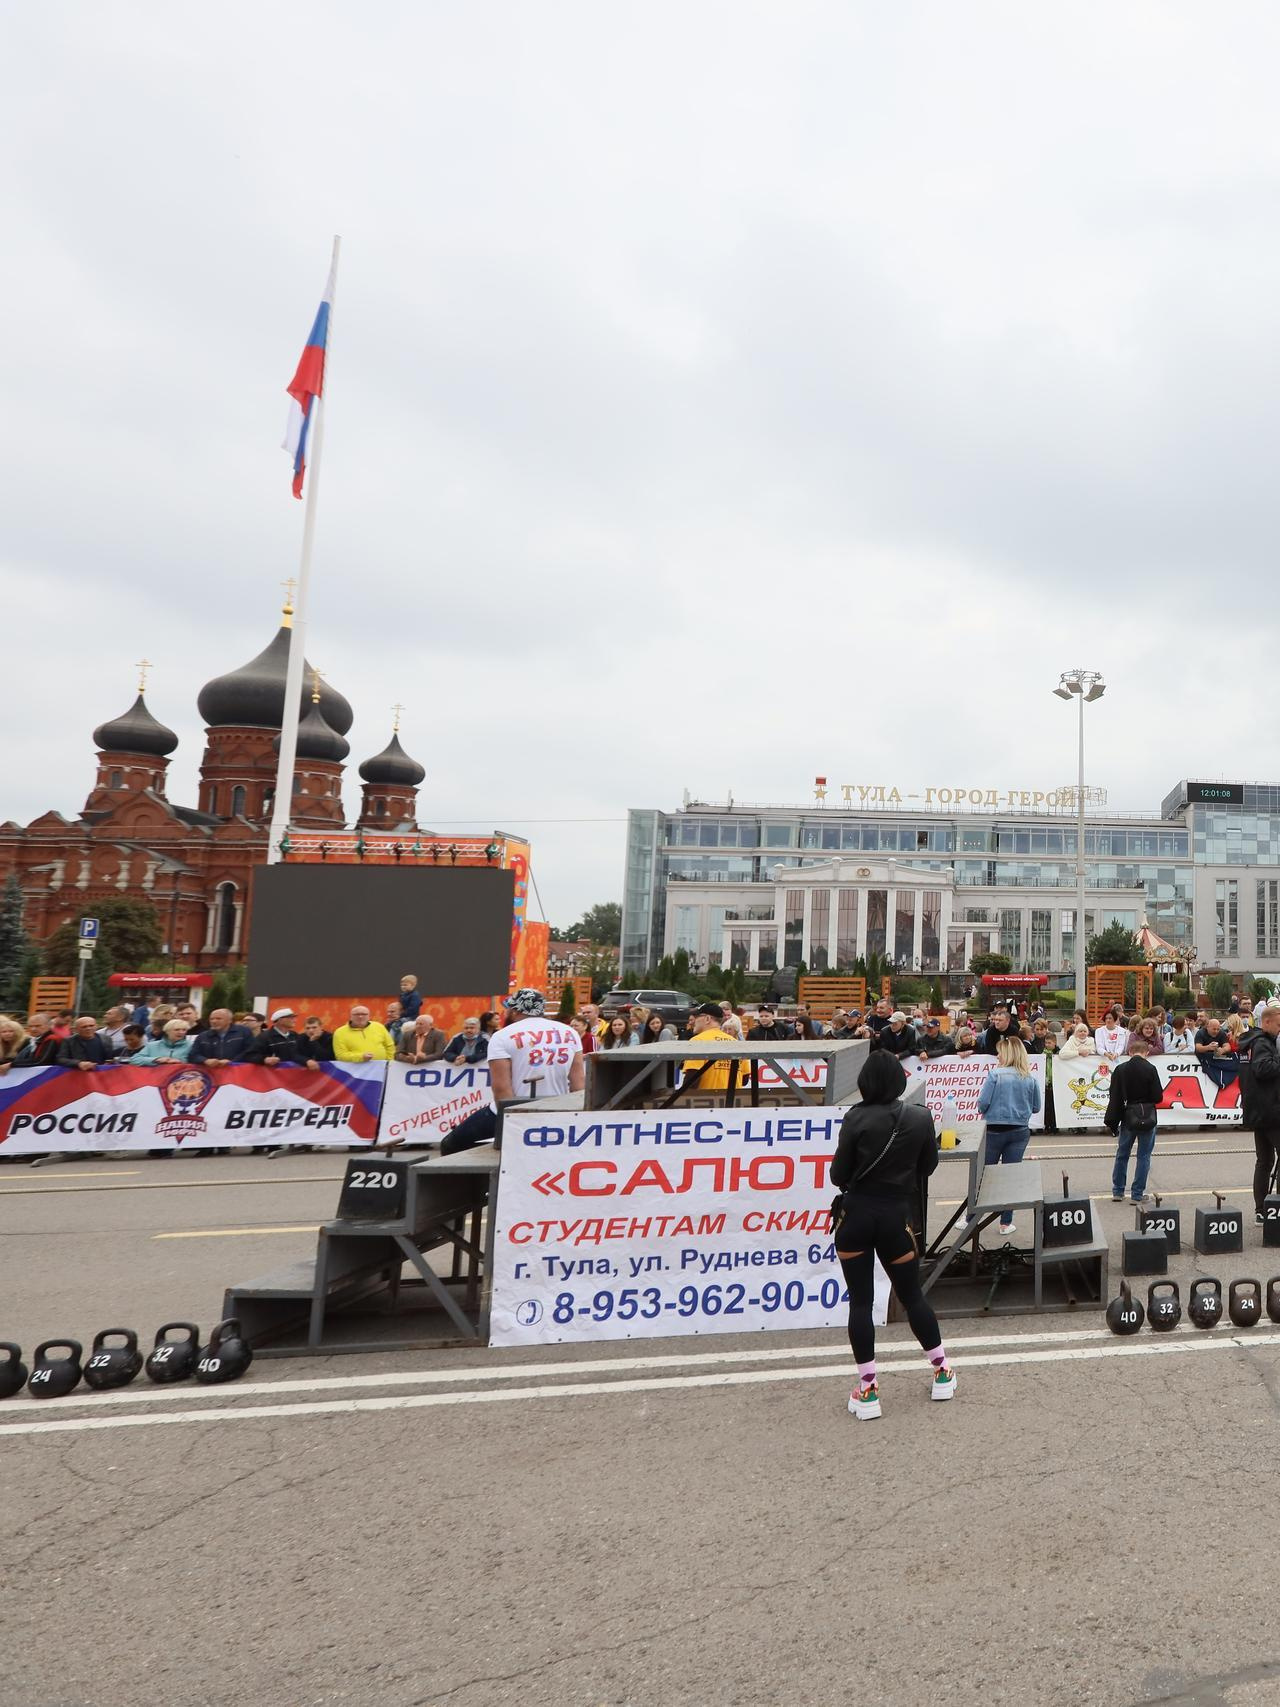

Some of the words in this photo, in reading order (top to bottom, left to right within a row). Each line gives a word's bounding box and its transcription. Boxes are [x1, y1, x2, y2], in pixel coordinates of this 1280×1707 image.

[840, 784, 903, 802] ТУЛА
[1200, 789, 1231, 798] 12:01:08
[510, 1029, 577, 1050] ТУЛА
[528, 1047, 569, 1067] 875
[924, 1063, 980, 1073] ТЯЖЕЛАЯ
[926, 1088, 980, 1098] ПАУЭРЛИ
[224, 1105, 353, 1130] ВПЕРЕД!
[389, 1089, 482, 1136] СТУДЕНТАМ
[9, 1113, 138, 1135] РОССИЯ
[157, 1119, 206, 1132] НАЦИЯ
[523, 1119, 844, 1148] ФИТНЕС-ЦЕН
[348, 1171, 398, 1190] 220
[1049, 1209, 1087, 1228] 180
[1146, 1218, 1176, 1232] 220
[508, 1213, 726, 1246] СТУДЕНТАМ
[742, 1209, 833, 1236] СКИД
[1208, 1220, 1238, 1235] 200
[514, 1262, 531, 1279] г.
[542, 1256, 619, 1281] Тула,
[628, 1255, 670, 1278] ул.
[681, 1248, 798, 1274] Руднева
[552, 1278, 851, 1325] 8-953-962-90-0
[1160, 1303, 1174, 1314] 32
[1202, 1297, 1215, 1310] 32
[1241, 1299, 1254, 1309] 24
[1120, 1311, 1137, 1323] 40
[89, 1355, 112, 1368] 32
[152, 1346, 175, 1363] 32
[198, 1358, 221, 1372] 40
[31, 1369, 52, 1383] 24
